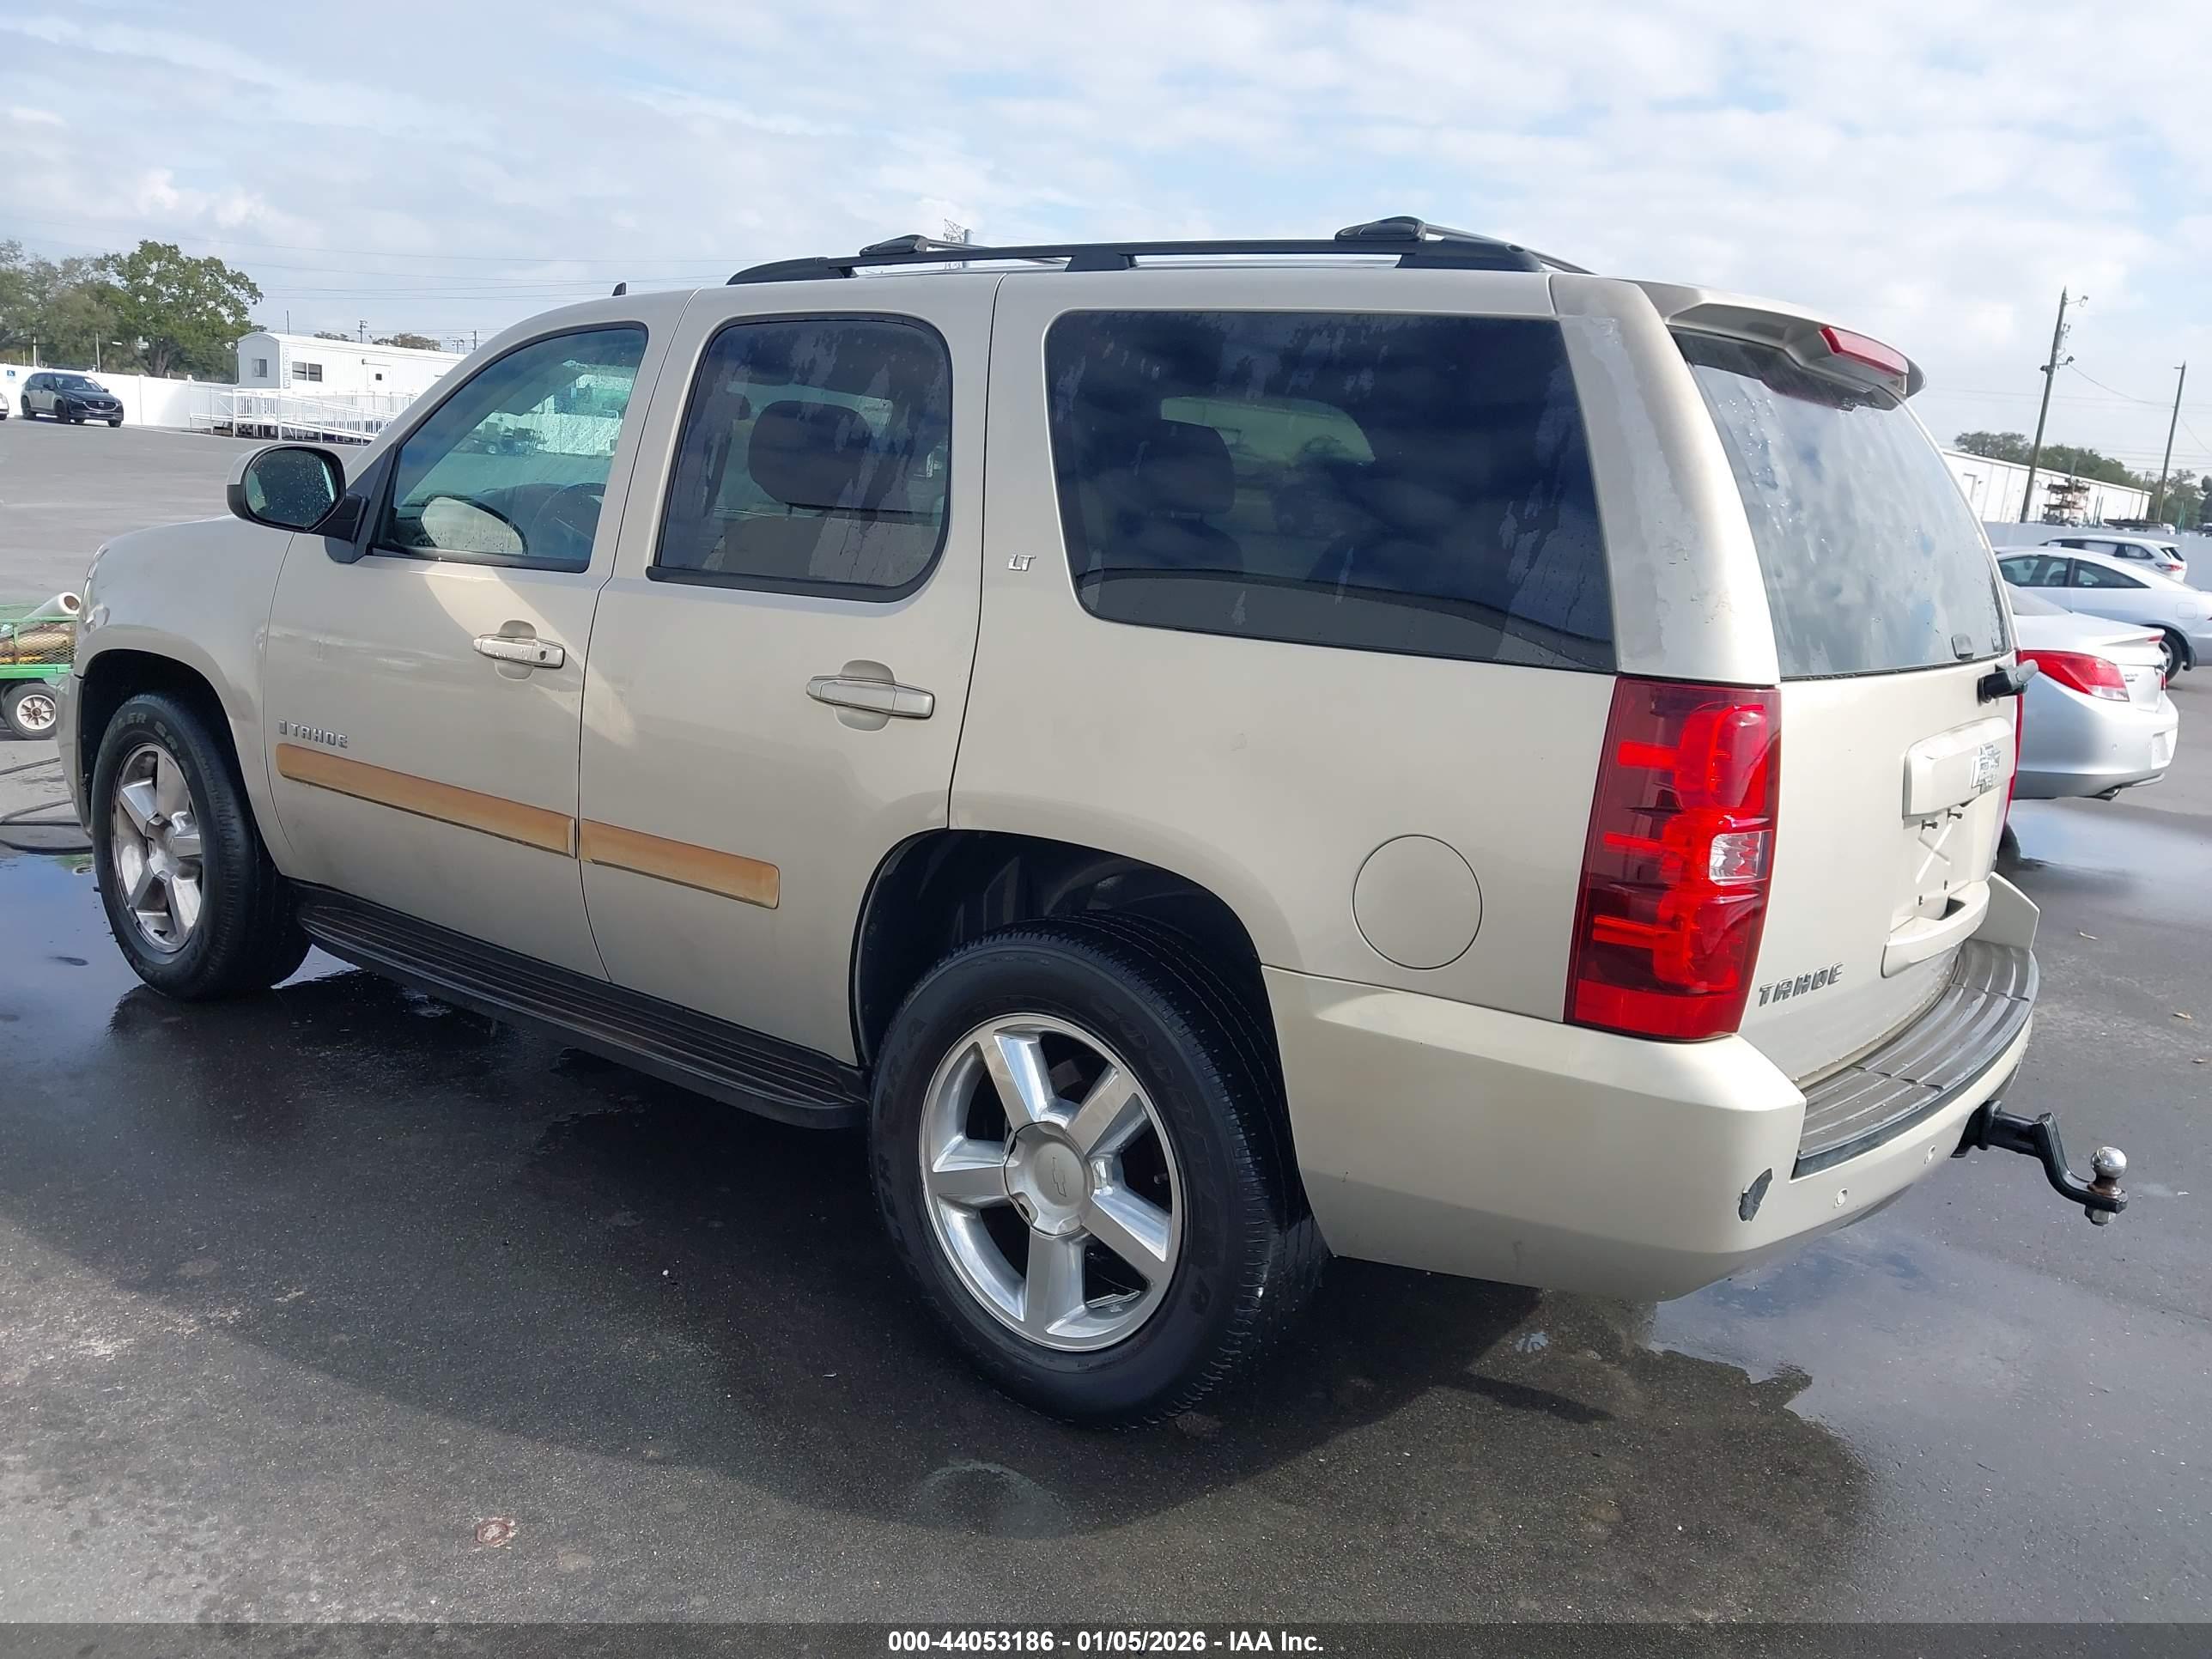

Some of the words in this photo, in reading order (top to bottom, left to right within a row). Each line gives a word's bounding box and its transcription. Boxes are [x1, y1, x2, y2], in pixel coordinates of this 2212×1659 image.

[1008, 554, 1036, 572] LT
[290, 722, 348, 749] TAHOE
[1759, 962, 1844, 1007] TAHOE
